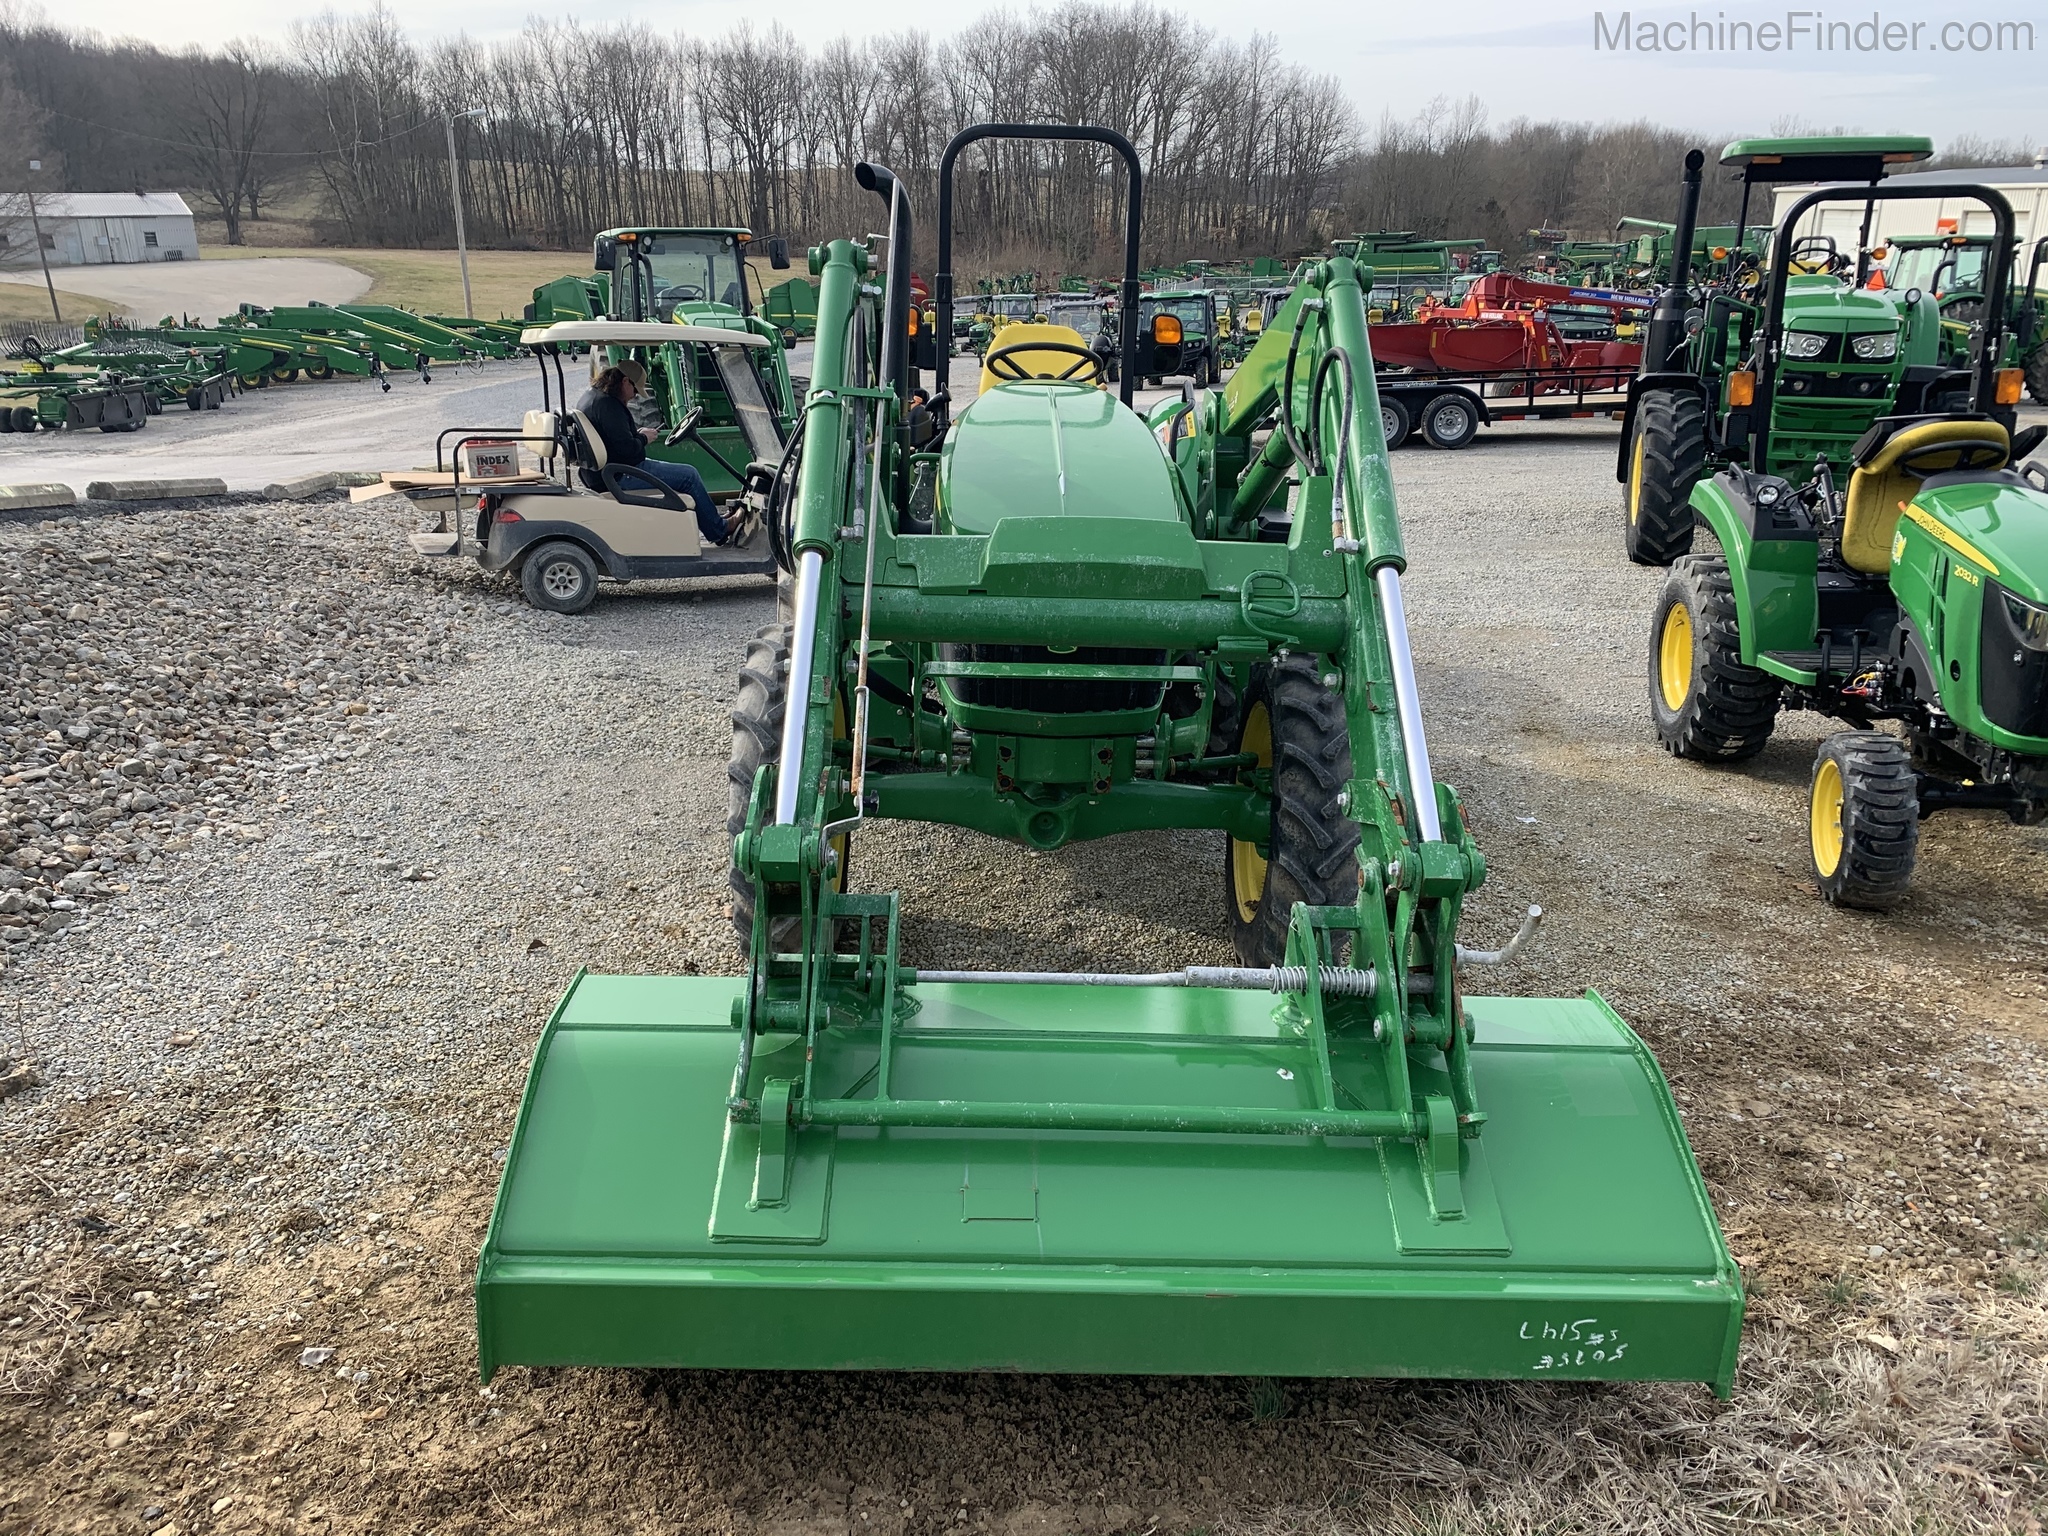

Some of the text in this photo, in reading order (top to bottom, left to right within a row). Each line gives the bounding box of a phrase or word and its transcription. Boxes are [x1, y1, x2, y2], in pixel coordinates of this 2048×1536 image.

[476, 455, 510, 466] INDEX
[1917, 515, 1946, 540] JOHN DEERE
